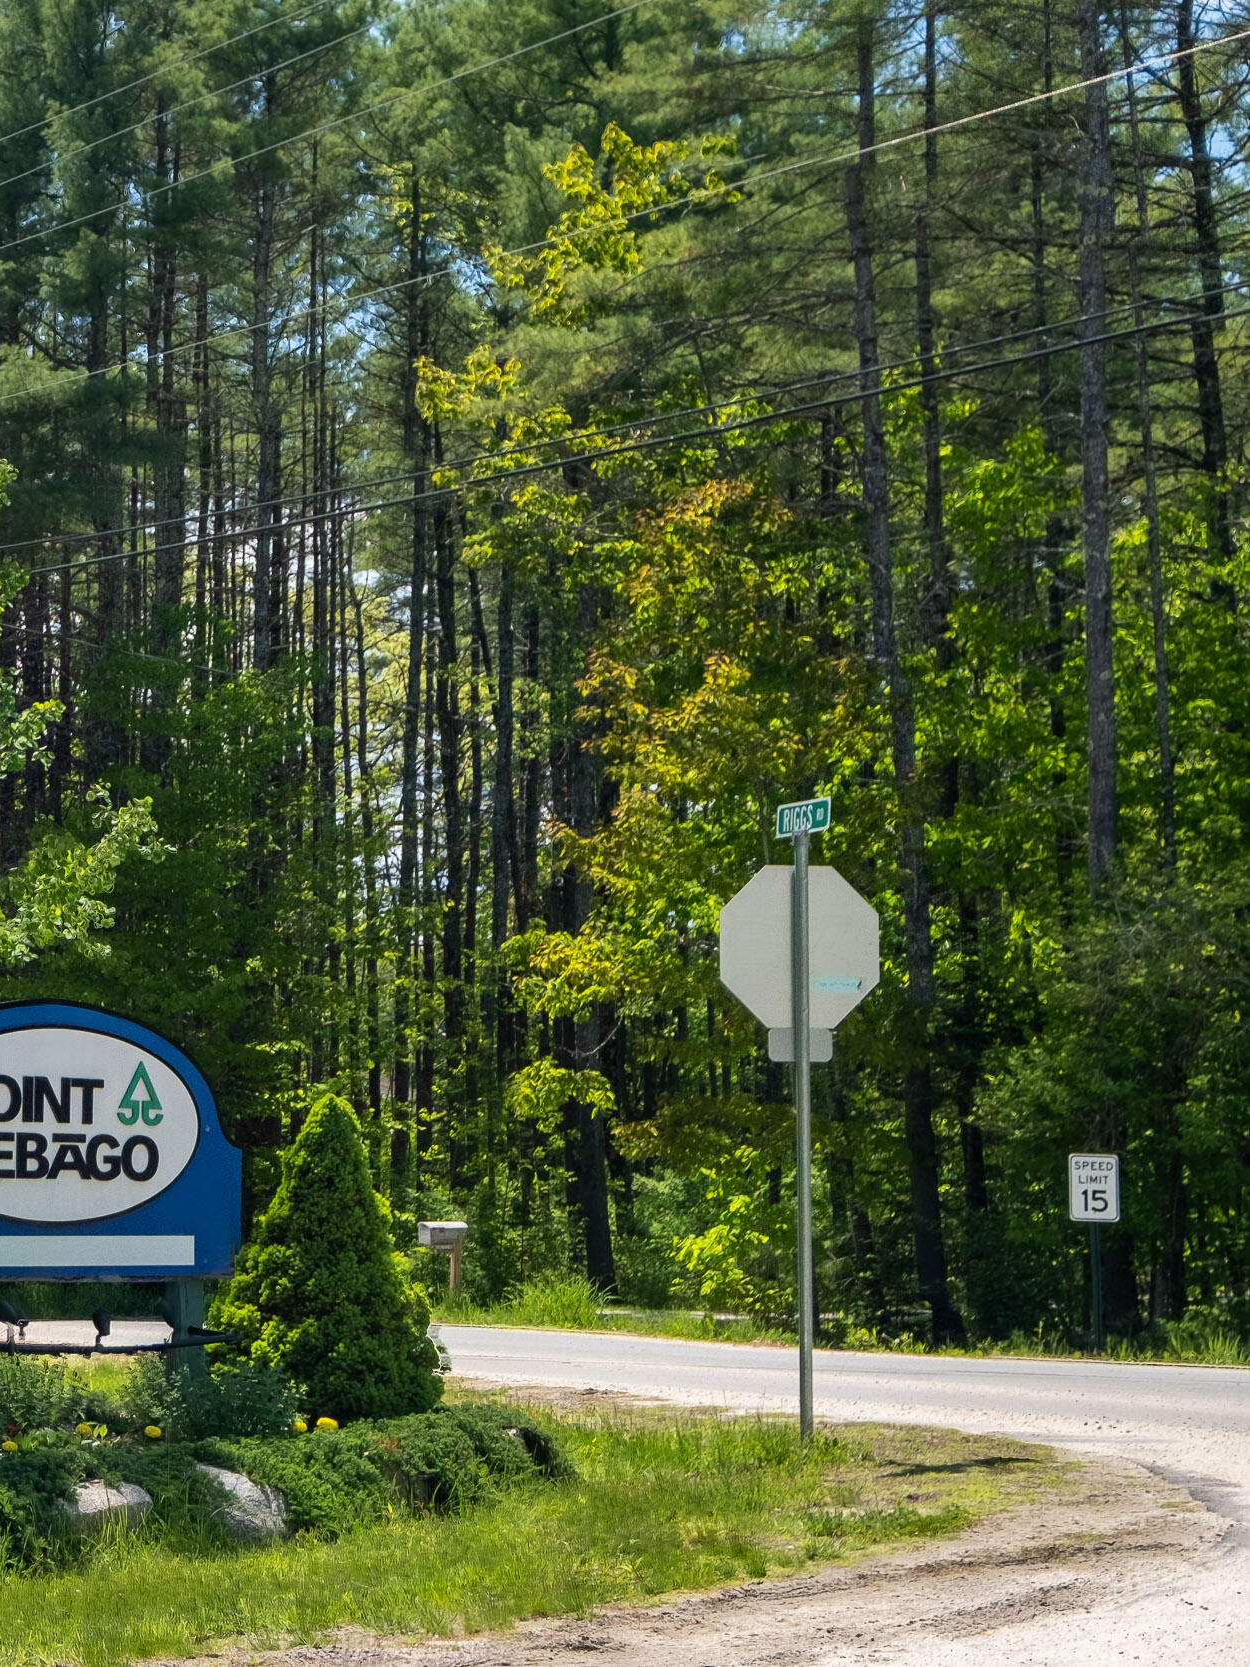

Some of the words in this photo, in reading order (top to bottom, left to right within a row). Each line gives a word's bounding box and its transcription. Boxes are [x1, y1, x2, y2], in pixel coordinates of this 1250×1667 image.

[783, 805, 813, 832] RIGGS
[1074, 1161, 1114, 1171] SPEED
[1078, 1175, 1109, 1184] LIMIT
[1081, 1189, 1108, 1212] 15
